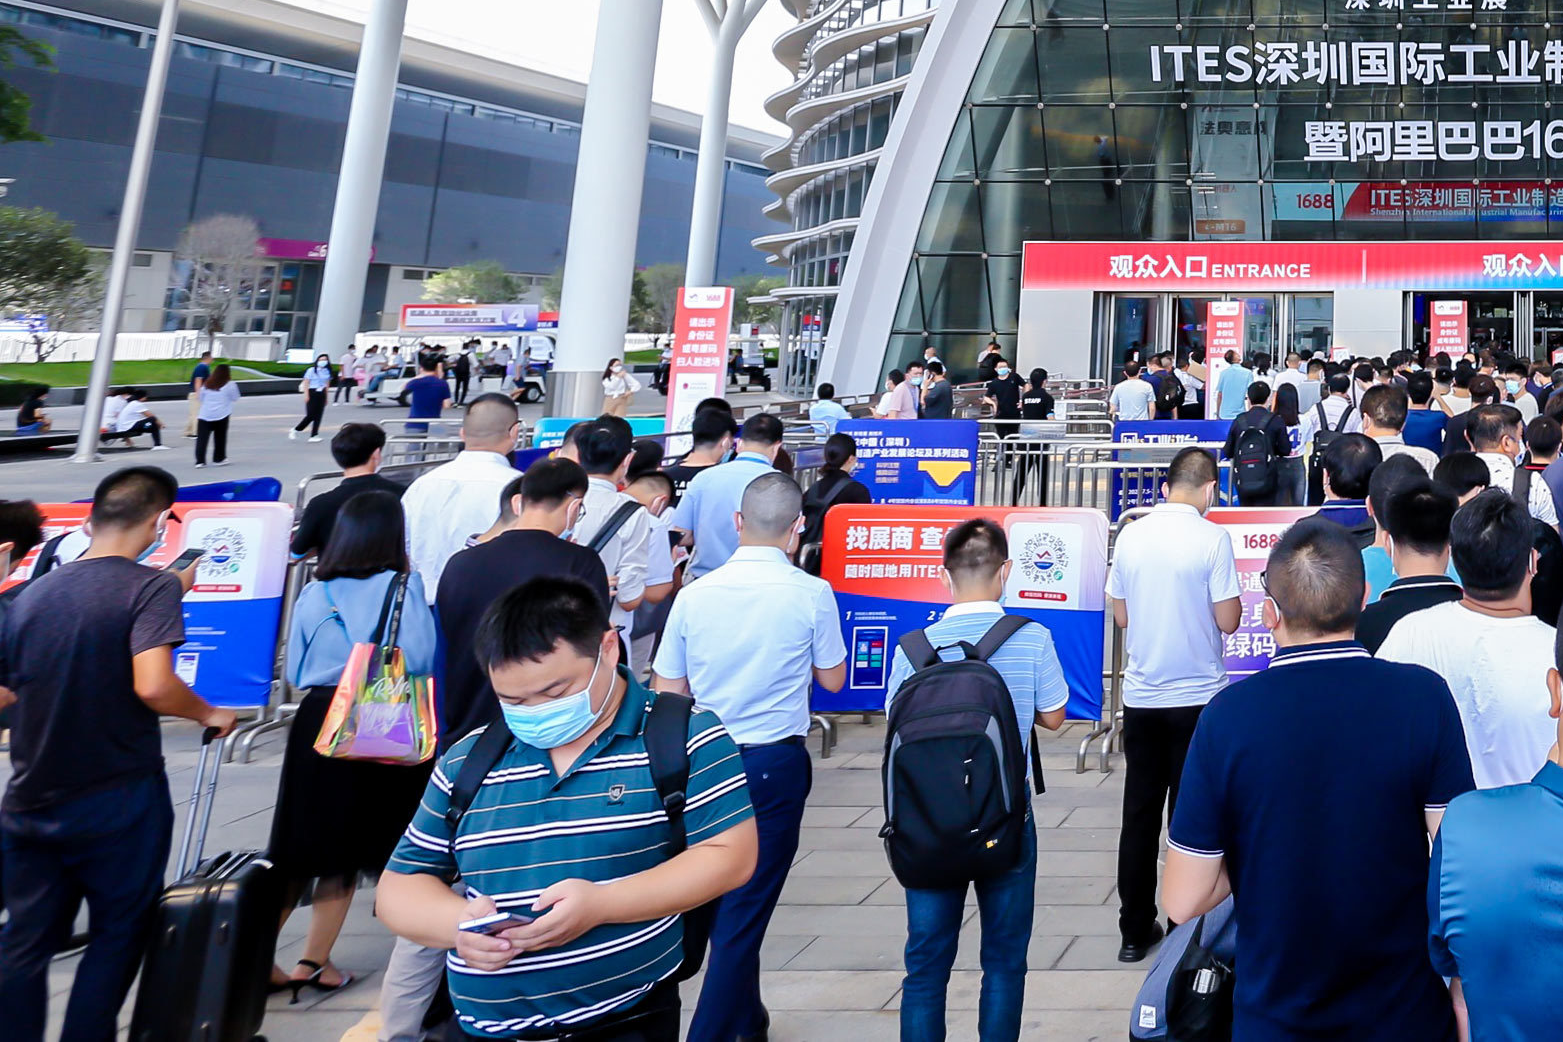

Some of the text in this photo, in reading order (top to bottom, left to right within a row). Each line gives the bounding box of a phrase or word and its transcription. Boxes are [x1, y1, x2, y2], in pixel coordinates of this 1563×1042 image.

[1297, 194, 1333, 208] 1688
[1467, 208, 1508, 216] Inustrial
[1109, 254, 1311, 278] 观众入口 ENTRANCE
[846, 526, 913, 551] 找展商
[1243, 534, 1279, 549] 1688
[845, 611, 852, 621] 1
[927, 610, 937, 621] 2
[1221, 633, 1277, 659] 绿码
